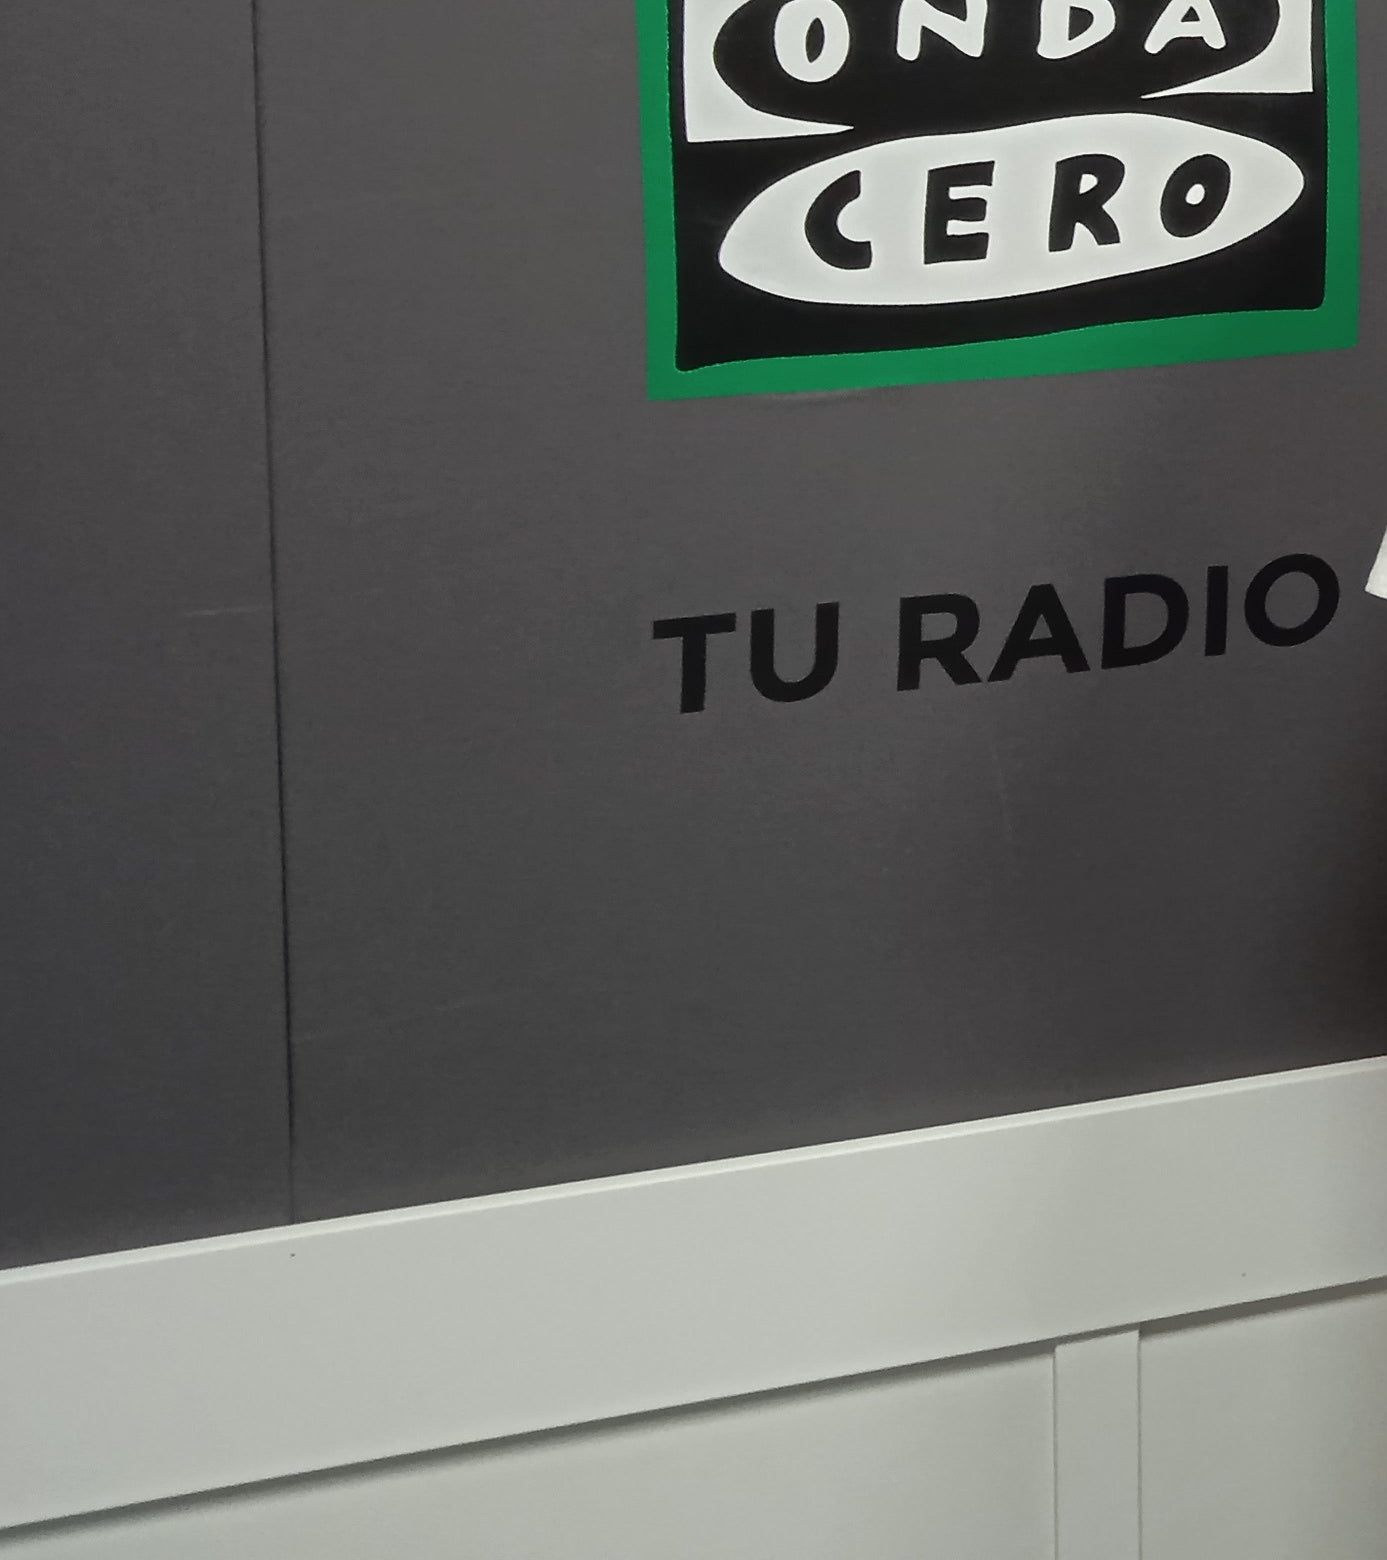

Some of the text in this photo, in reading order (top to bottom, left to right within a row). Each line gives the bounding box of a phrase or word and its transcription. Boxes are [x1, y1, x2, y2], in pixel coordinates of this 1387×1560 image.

[804, 153, 1231, 271] CERO
[653, 553, 1341, 714] TU RADIO
